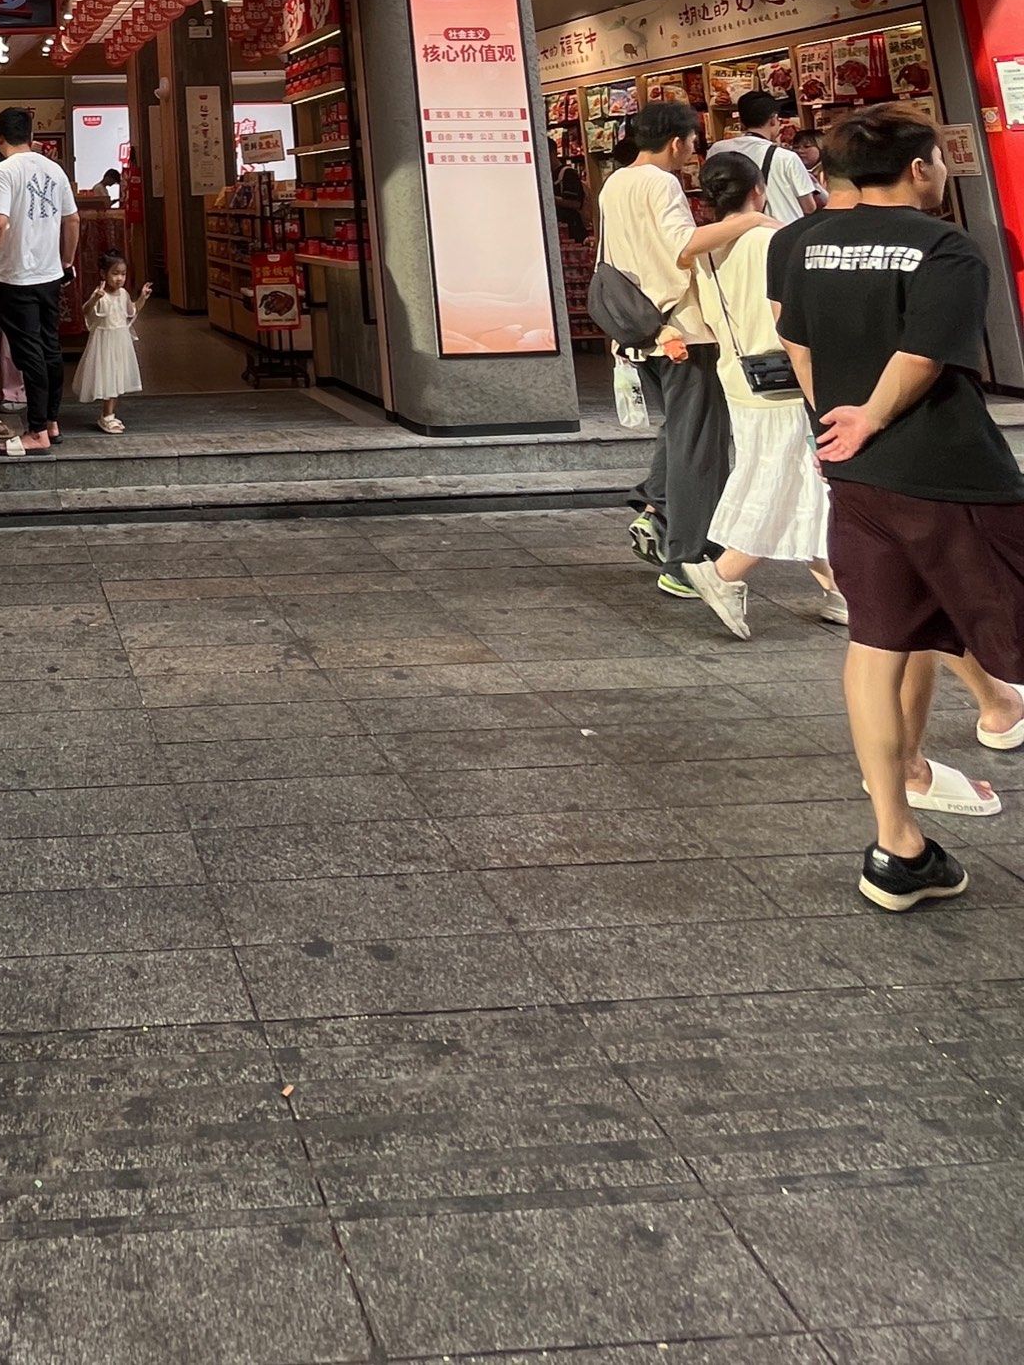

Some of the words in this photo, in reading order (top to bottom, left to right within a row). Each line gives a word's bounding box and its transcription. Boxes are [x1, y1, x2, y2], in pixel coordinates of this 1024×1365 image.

[448, 29, 486, 40] 社会主义
[538, 27, 597, 61] 大的福气牛
[422, 44, 516, 63] 核心价值观
[26, 172, 59, 220] NY
[804, 244, 924, 272] UNDEFEATED
